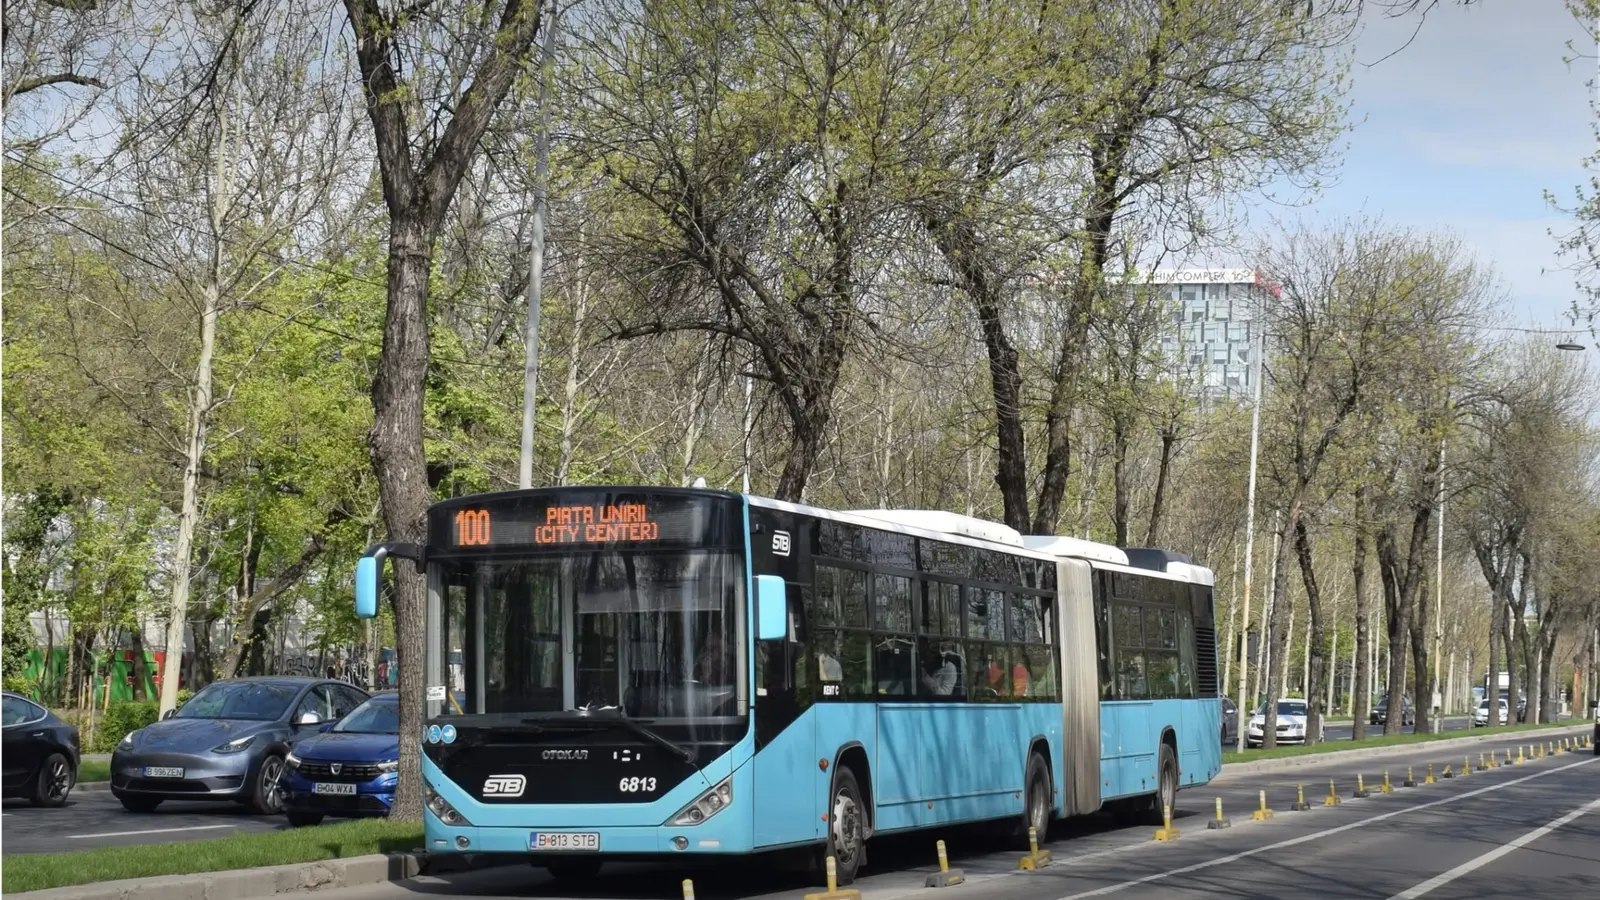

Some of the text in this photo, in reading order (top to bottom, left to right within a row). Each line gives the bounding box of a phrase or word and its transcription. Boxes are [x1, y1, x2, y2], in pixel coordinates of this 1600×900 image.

[1148, 271, 1226, 282] HIMCOMPLEX
[546, 504, 646, 525] PIATA UNIRII
[455, 509, 491, 545] 100
[534, 522, 658, 543] (CITY CENTER)
[772, 533, 789, 552] STB
[835, 685, 840, 696] C
[542, 749, 589, 760] OTOKAR
[336, 784, 353, 793] WXA
[482, 777, 522, 793] STB
[619, 776, 657, 792] 6813
[538, 834, 596, 847] B 813 STB
